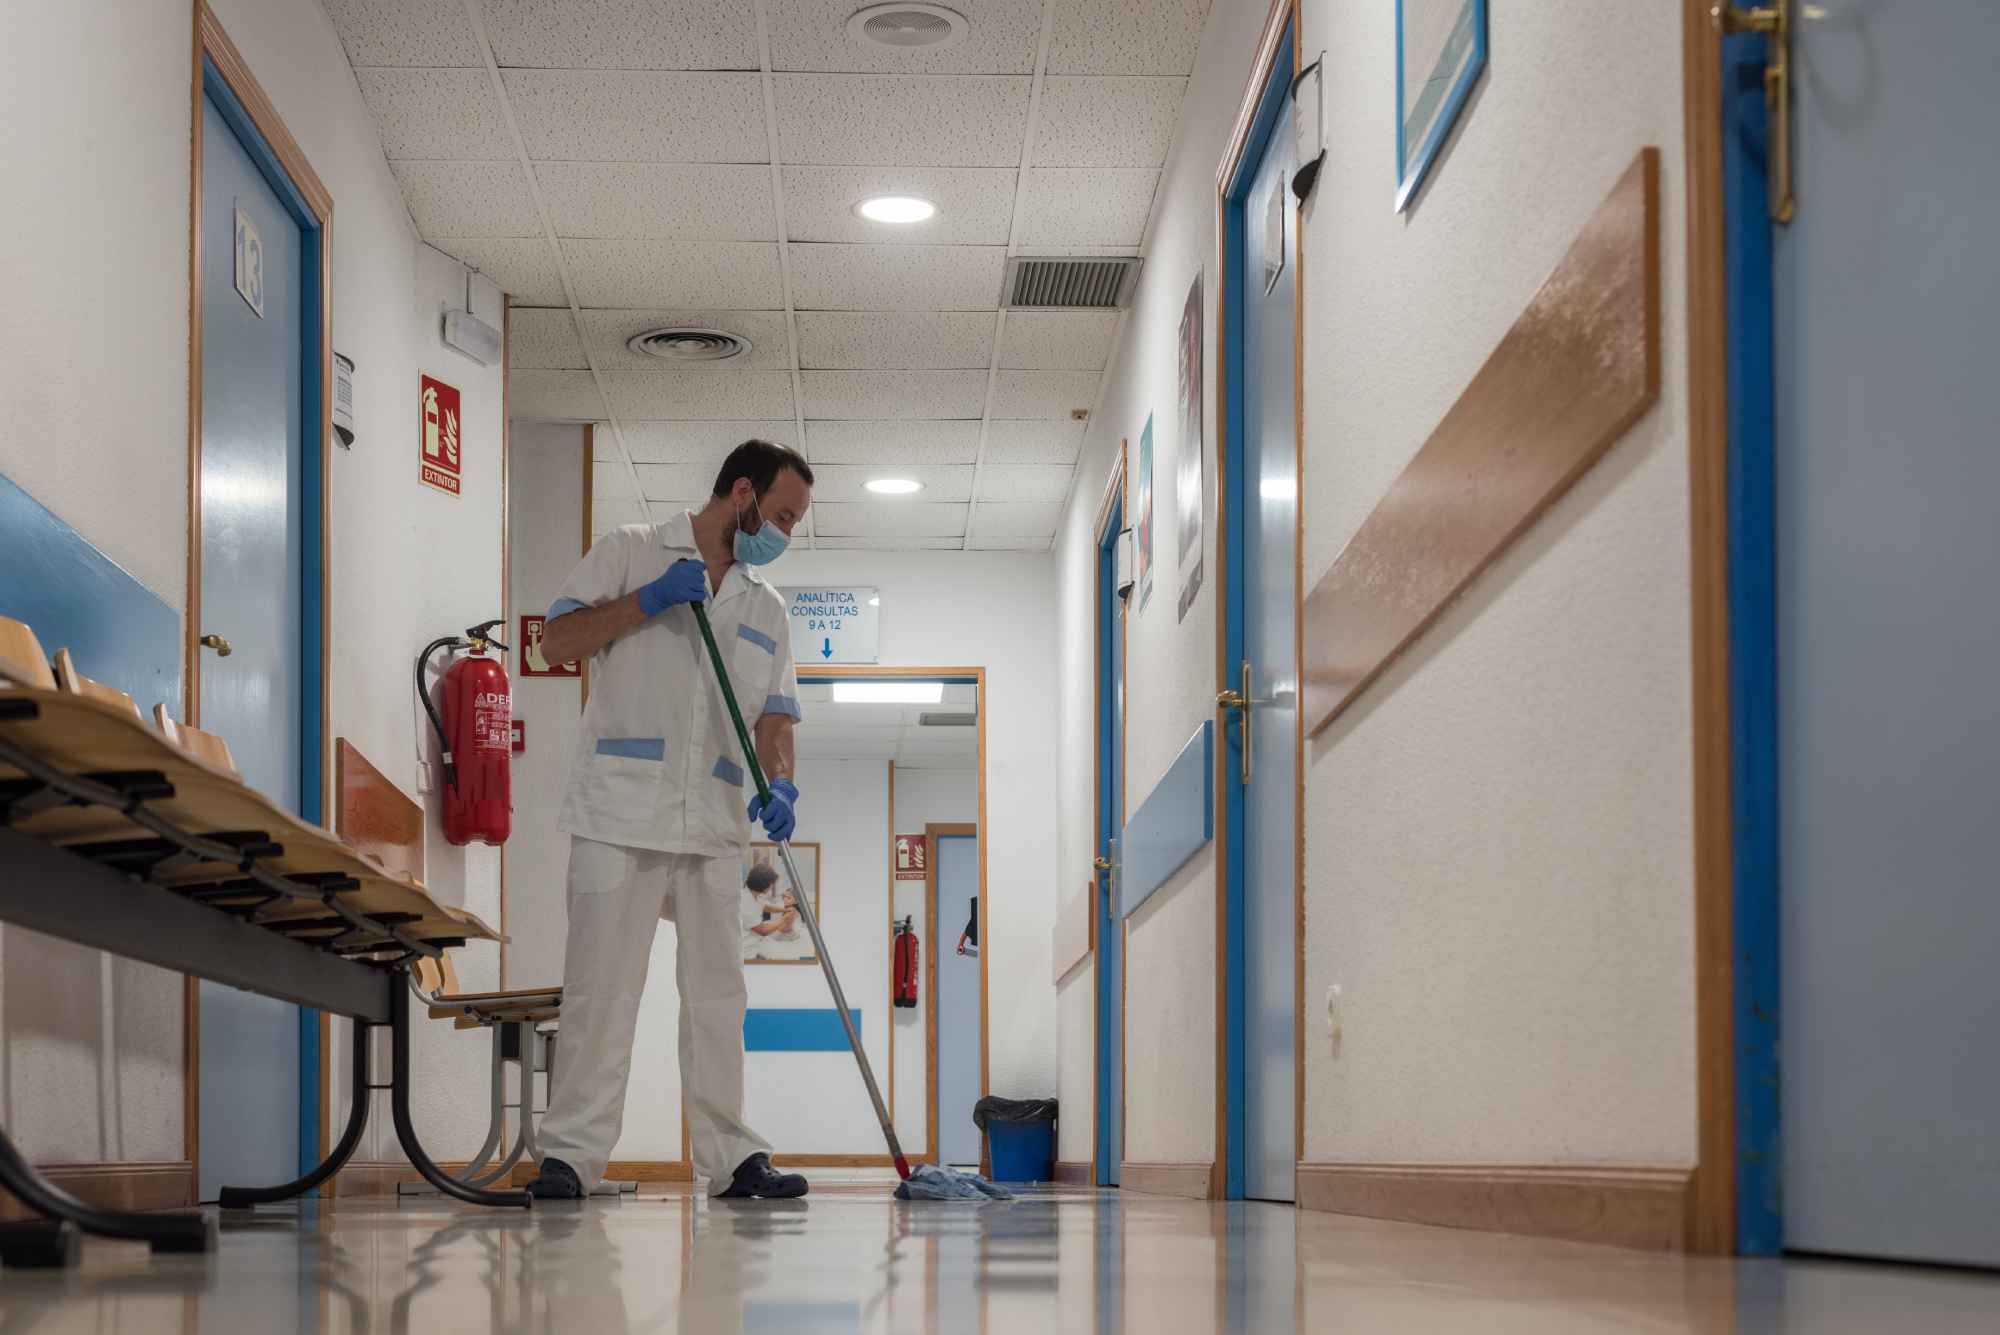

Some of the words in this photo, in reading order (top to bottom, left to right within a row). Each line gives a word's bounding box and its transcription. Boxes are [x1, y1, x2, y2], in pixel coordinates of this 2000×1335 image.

[238, 224, 260, 304] 13
[424, 468, 457, 491] EXTINTOR
[796, 590, 855, 603] ANALÍTICA
[791, 605, 859, 617] CONSULTAS
[808, 619, 816, 630] 9
[818, 619, 826, 630] A
[830, 619, 841, 630] 12
